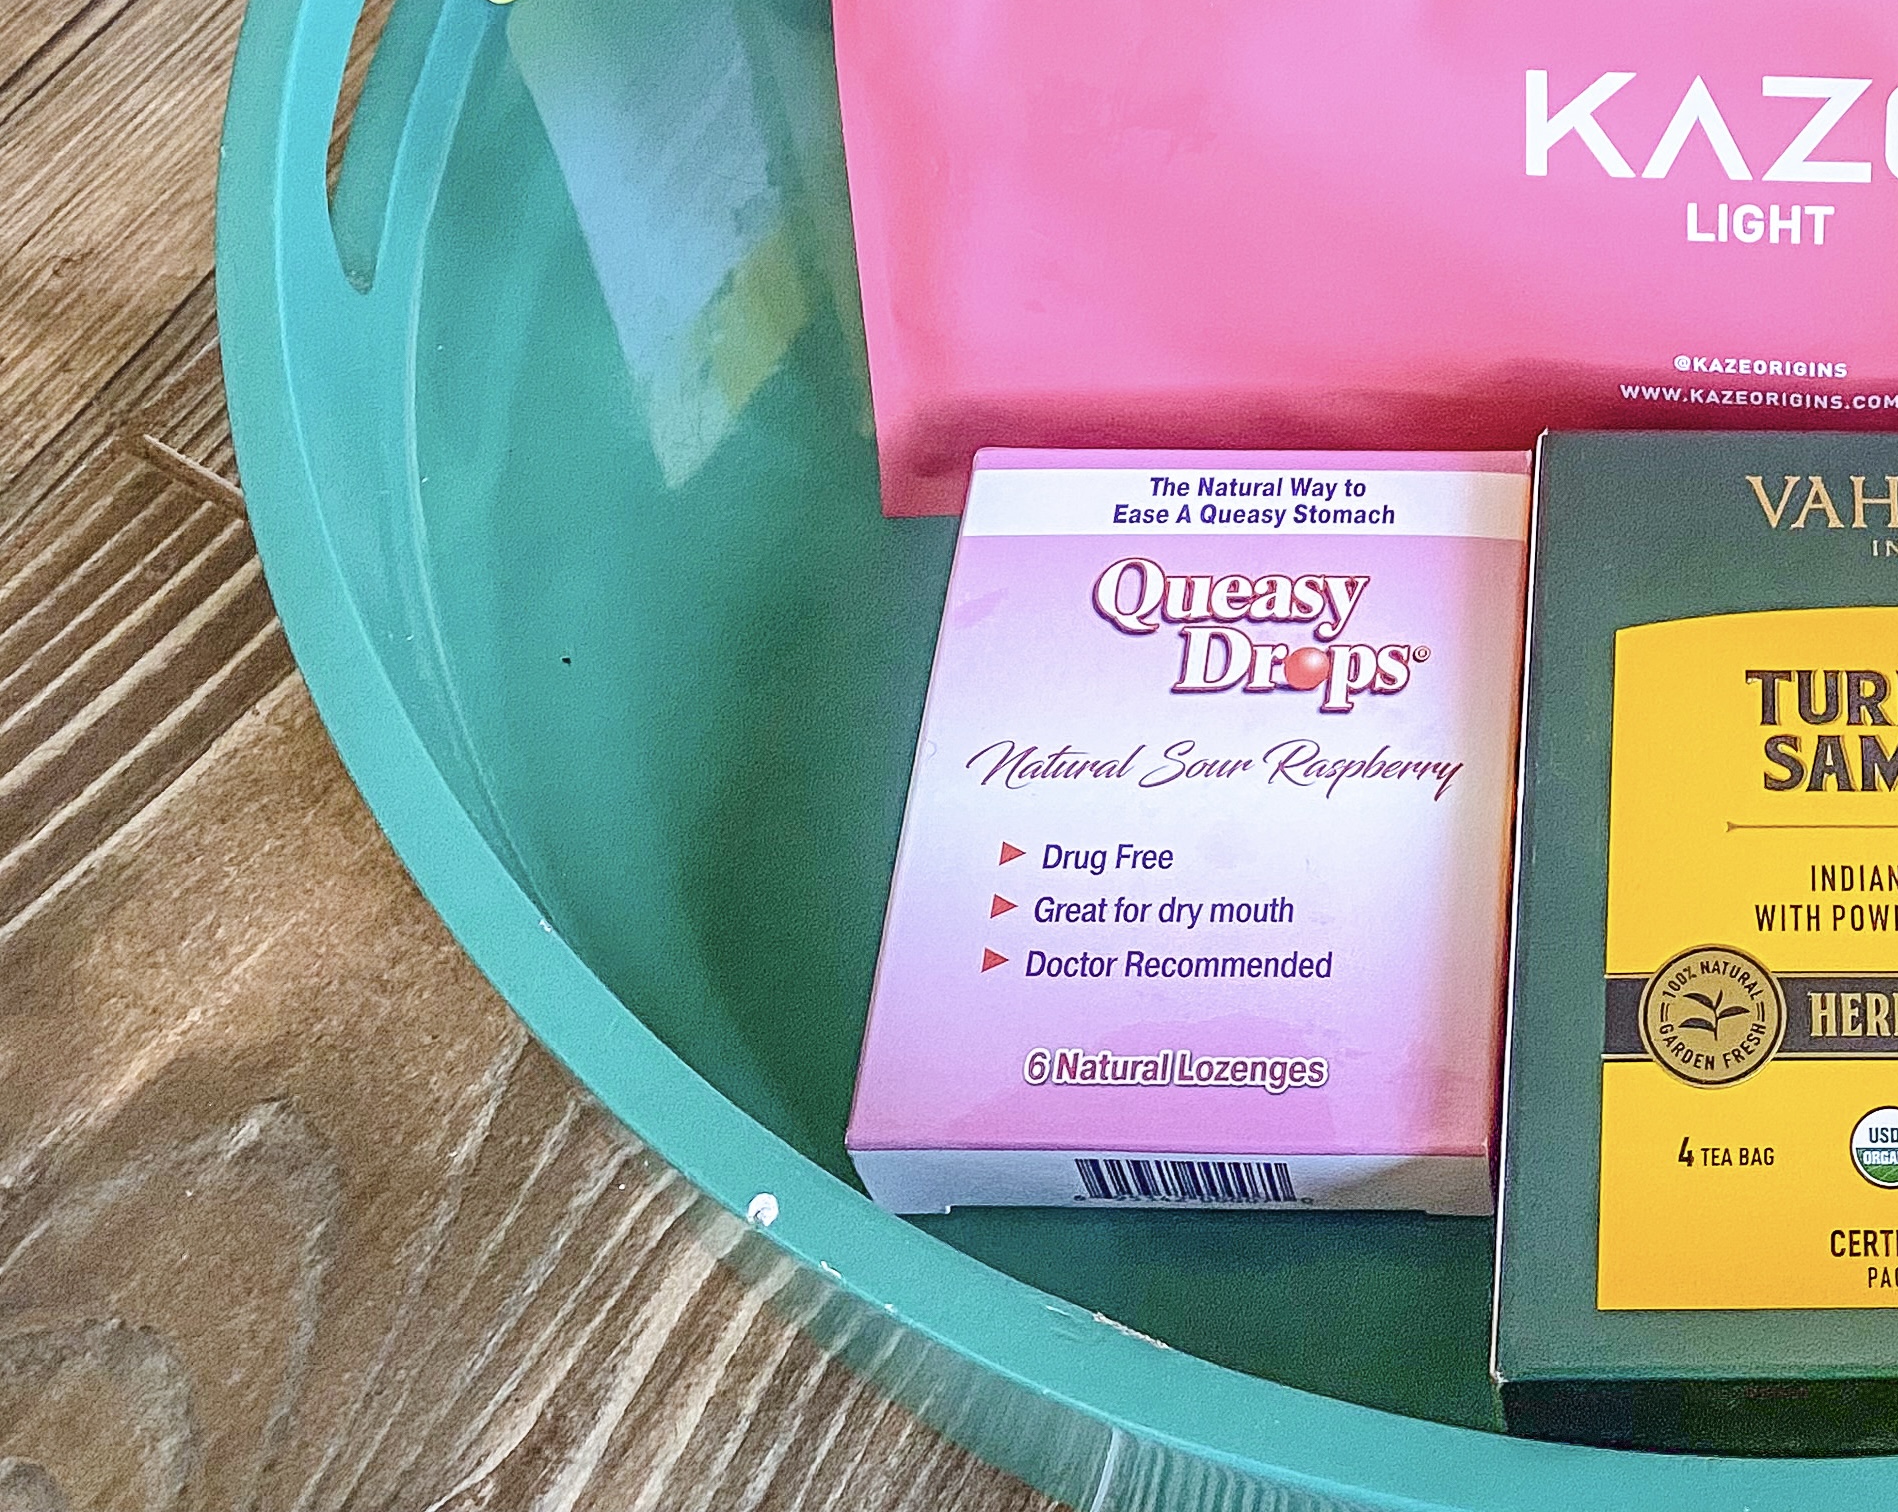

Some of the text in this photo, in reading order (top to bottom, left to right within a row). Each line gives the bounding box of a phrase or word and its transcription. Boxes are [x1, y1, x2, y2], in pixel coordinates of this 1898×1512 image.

[1687, 202, 1835, 244] LIGHT
[1673, 355, 1848, 379] @KAZEORIGINS
[1148, 477, 1367, 502] The Natural Way to
[1112, 502, 1396, 529] Ease A Queasy Stomach
[1091, 556, 1371, 640] Queasy
[963, 737, 1466, 801] Natural Sour Raspberry
[1041, 843, 1174, 876] Drug Free
[1033, 896, 1295, 930] Great for dry mouth
[1754, 904, 1822, 933] WITH
[1024, 950, 1333, 979] Doctor Recommended
[1663, 958, 1764, 1000] 100% NATURAL
[1659, 1022, 1767, 1071] GARDEN FRESH
[1024, 1049, 1330, 1094] 6 Natural Lozenges
[1677, 1138, 1775, 1168] 4 TEA BAG
